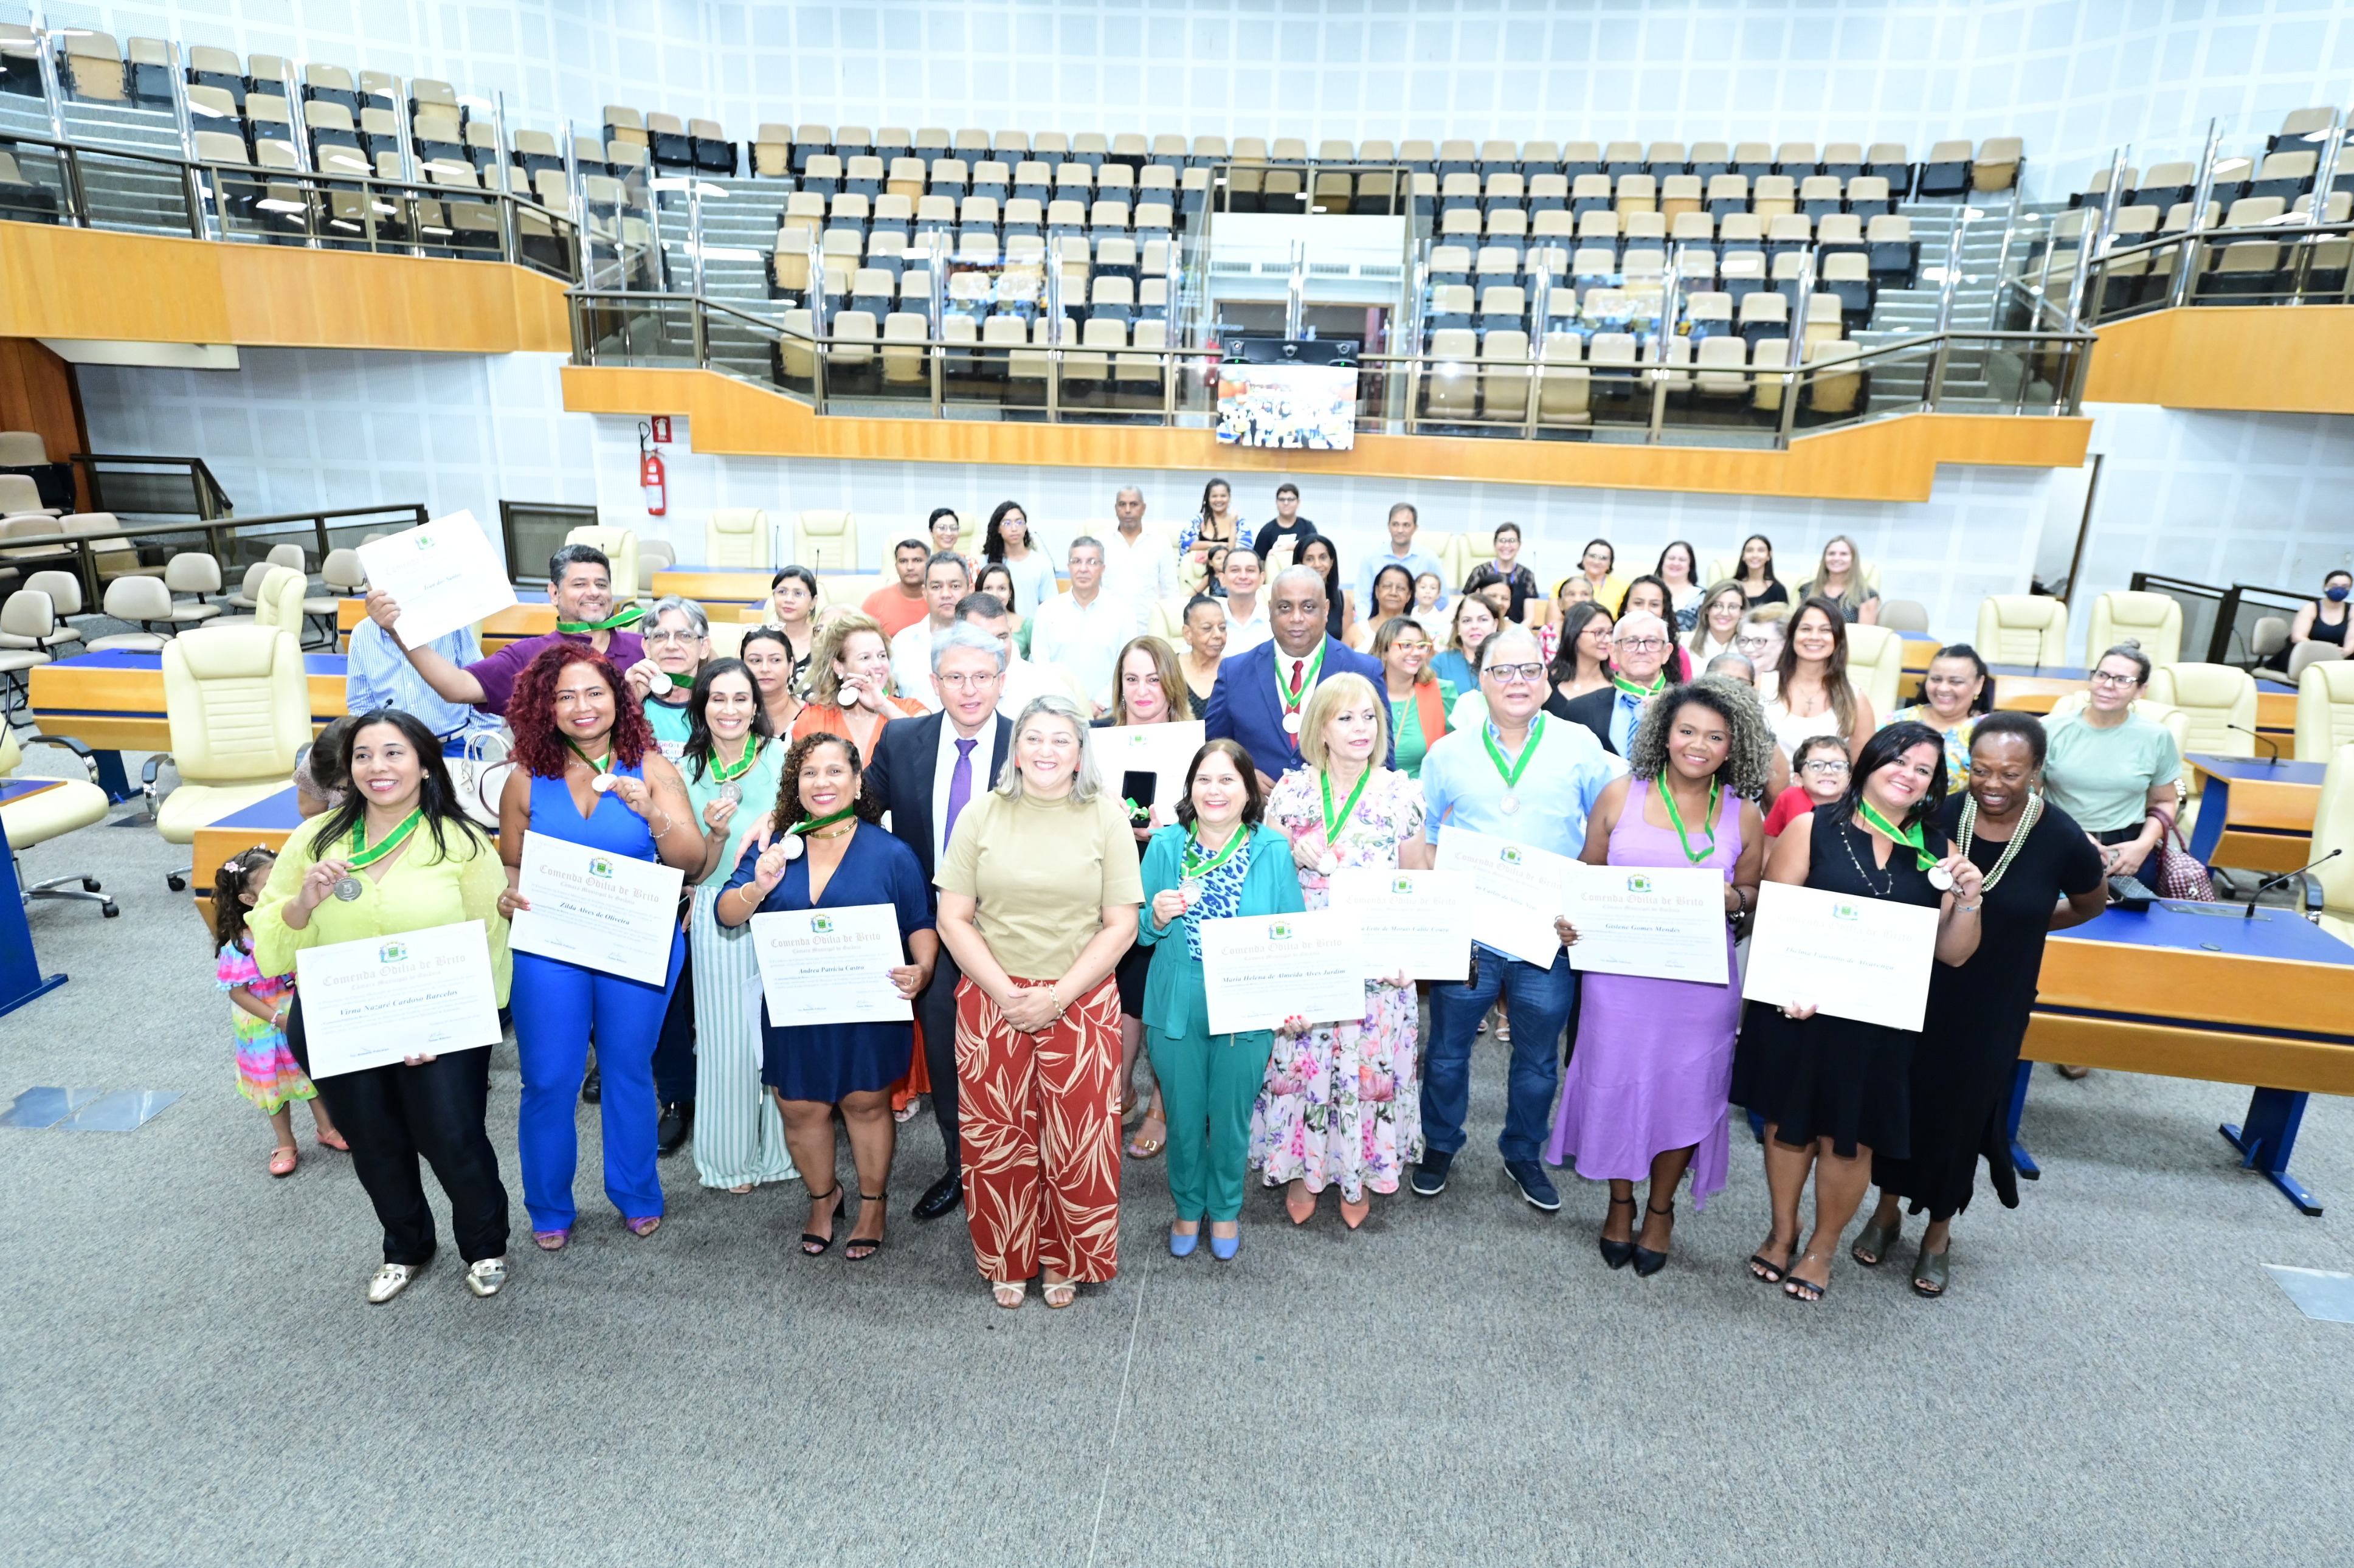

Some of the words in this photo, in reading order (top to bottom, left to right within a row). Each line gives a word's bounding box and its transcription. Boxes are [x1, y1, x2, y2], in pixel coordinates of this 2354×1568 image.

[539, 865, 582, 883] Comenda
[618, 885, 629, 895] de
[632, 888, 659, 903] Brito
[1525, 872, 1534, 881] de
[1580, 892, 1623, 903] Comenda
[1661, 896, 1671, 905] de
[1676, 896, 1703, 906] Brito
[559, 902, 576, 911] Zilda
[579, 907, 594, 916] Alves
[604, 914, 630, 925] Oliveira
[770, 938, 810, 948] Comenda
[855, 932, 880, 941] Brito
[1221, 945, 1265, 955] Comenda
[1302, 941, 1311, 949] de
[1316, 938, 1342, 948] Brito
[322, 970, 376, 986] Comenda
[419, 961, 431, 969] de
[435, 955, 466, 967] Brito
[393, 996, 423, 1006] Cardoso
[426, 990, 457, 1000] Barcelos
